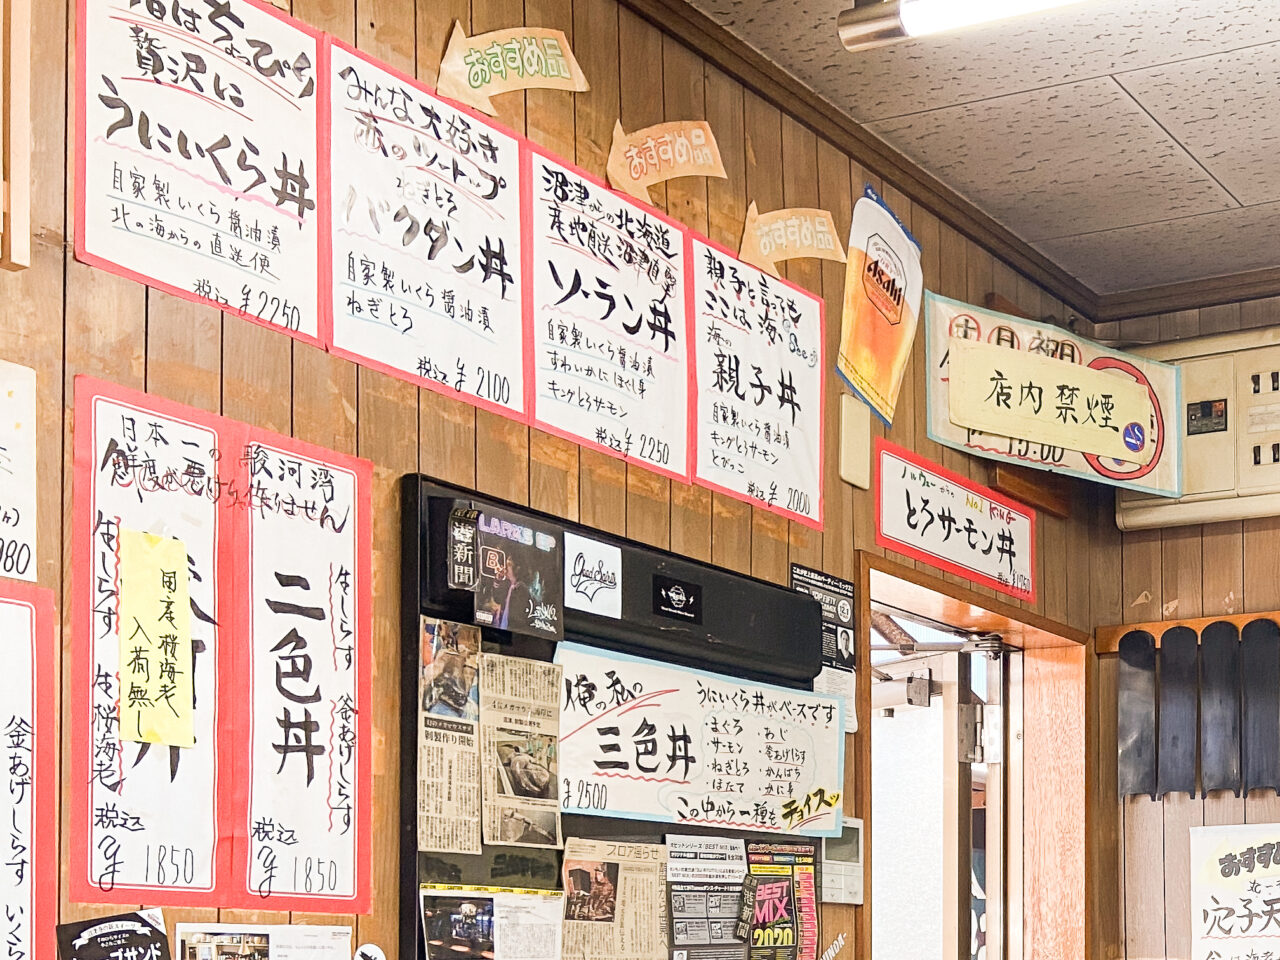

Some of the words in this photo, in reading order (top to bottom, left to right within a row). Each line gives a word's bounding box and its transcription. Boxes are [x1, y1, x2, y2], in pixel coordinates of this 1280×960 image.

[129, 24, 245, 108] 贅沢に
[464, 37, 571, 89] おすすめ品
[98, 74, 316, 230] うにいくら丼
[624, 127, 714, 182] おすすめ品
[345, 184, 515, 300] バクダン丼
[347, 291, 414, 335] ねぎとろ
[866, 260, 903, 307] Asahi
[712, 350, 802, 426] 親子丼
[984, 369, 1119, 433] 店内禁煙
[905, 489, 1016, 573] とろサーモン丼
[263, 569, 325, 789] 二色丼
[696, 679, 837, 724] うにいくら丼がベースです
[335, 695, 358, 837] 釜あげしらす
[593, 716, 698, 781] 三色丼
[754, 897, 793, 926] MIX
[756, 880, 790, 902] BEST
